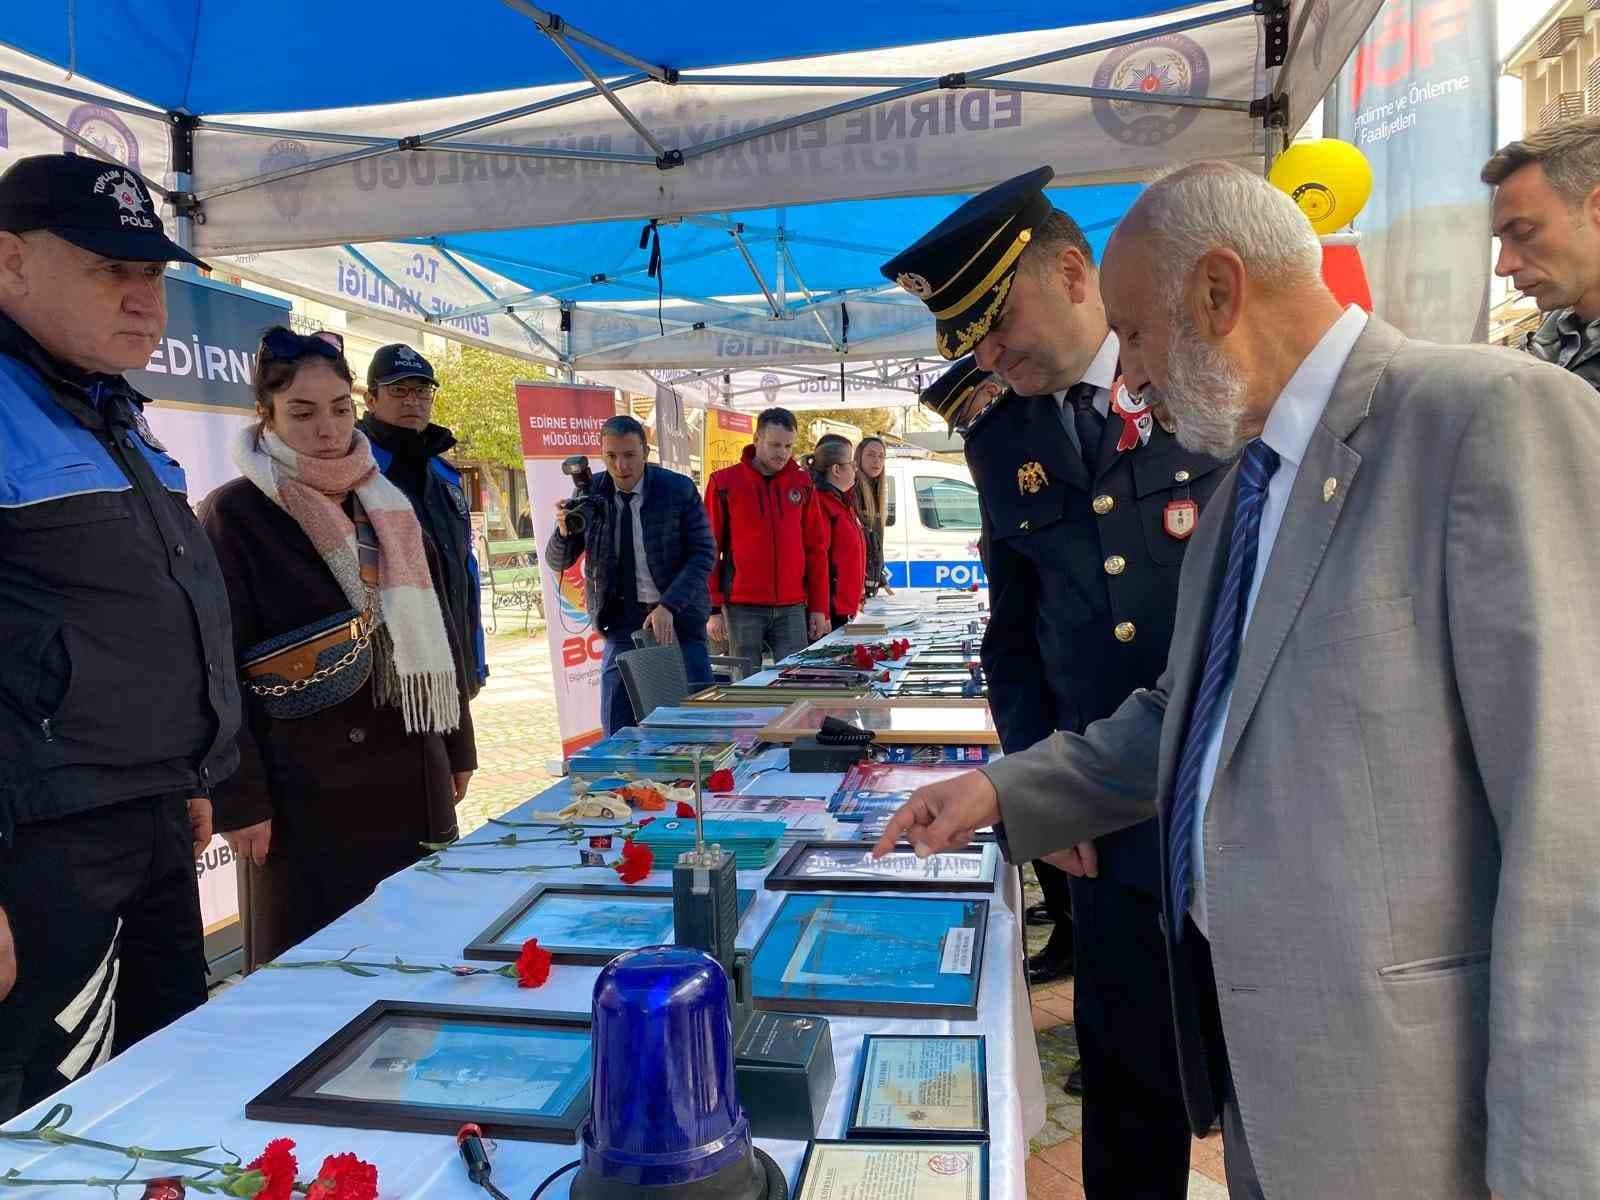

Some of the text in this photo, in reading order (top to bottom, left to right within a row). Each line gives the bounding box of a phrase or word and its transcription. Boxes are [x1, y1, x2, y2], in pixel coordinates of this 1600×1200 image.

[1408, 74, 1471, 104] Önleme
[145, 333, 257, 386] EDİRN
[529, 414, 609, 430] EDİRNE EMNİYE
[195, 845, 237, 879] ŞUB
